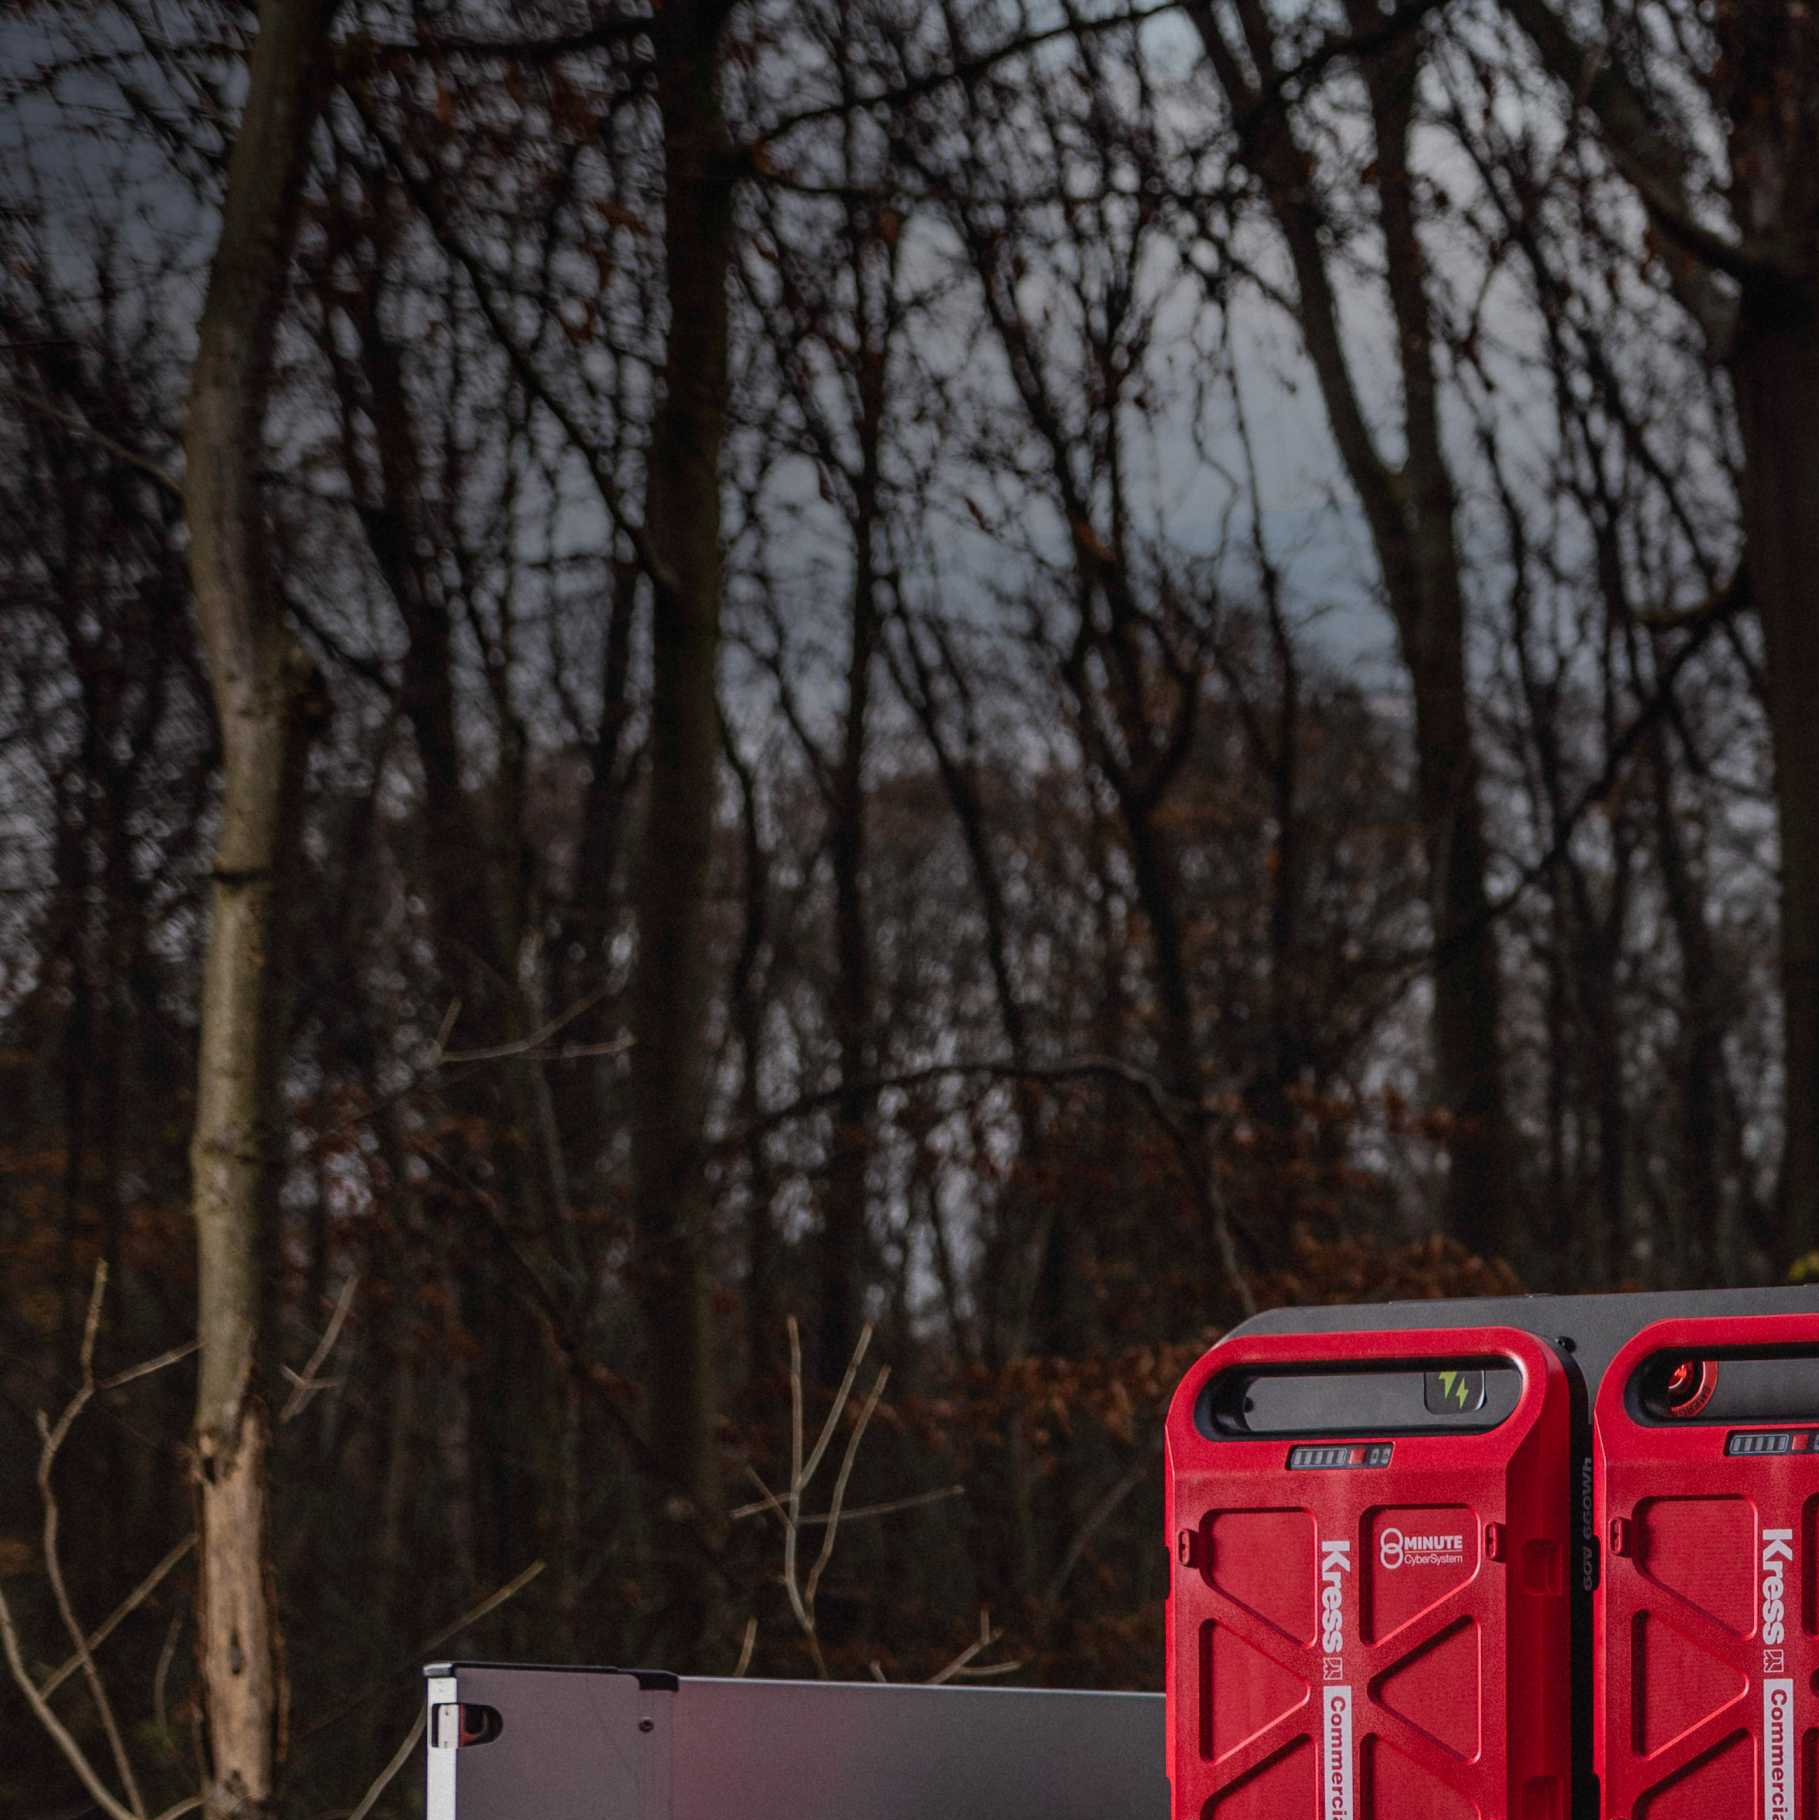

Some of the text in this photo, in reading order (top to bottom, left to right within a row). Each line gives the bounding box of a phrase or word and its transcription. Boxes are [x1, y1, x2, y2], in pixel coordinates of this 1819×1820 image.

[1403, 1554, 1463, 1566] CyberSystem
[1404, 1535, 1463, 1551] MINUTE
[1320, 1540, 1351, 1654] Kress
[1762, 1528, 1794, 1645] Kress
